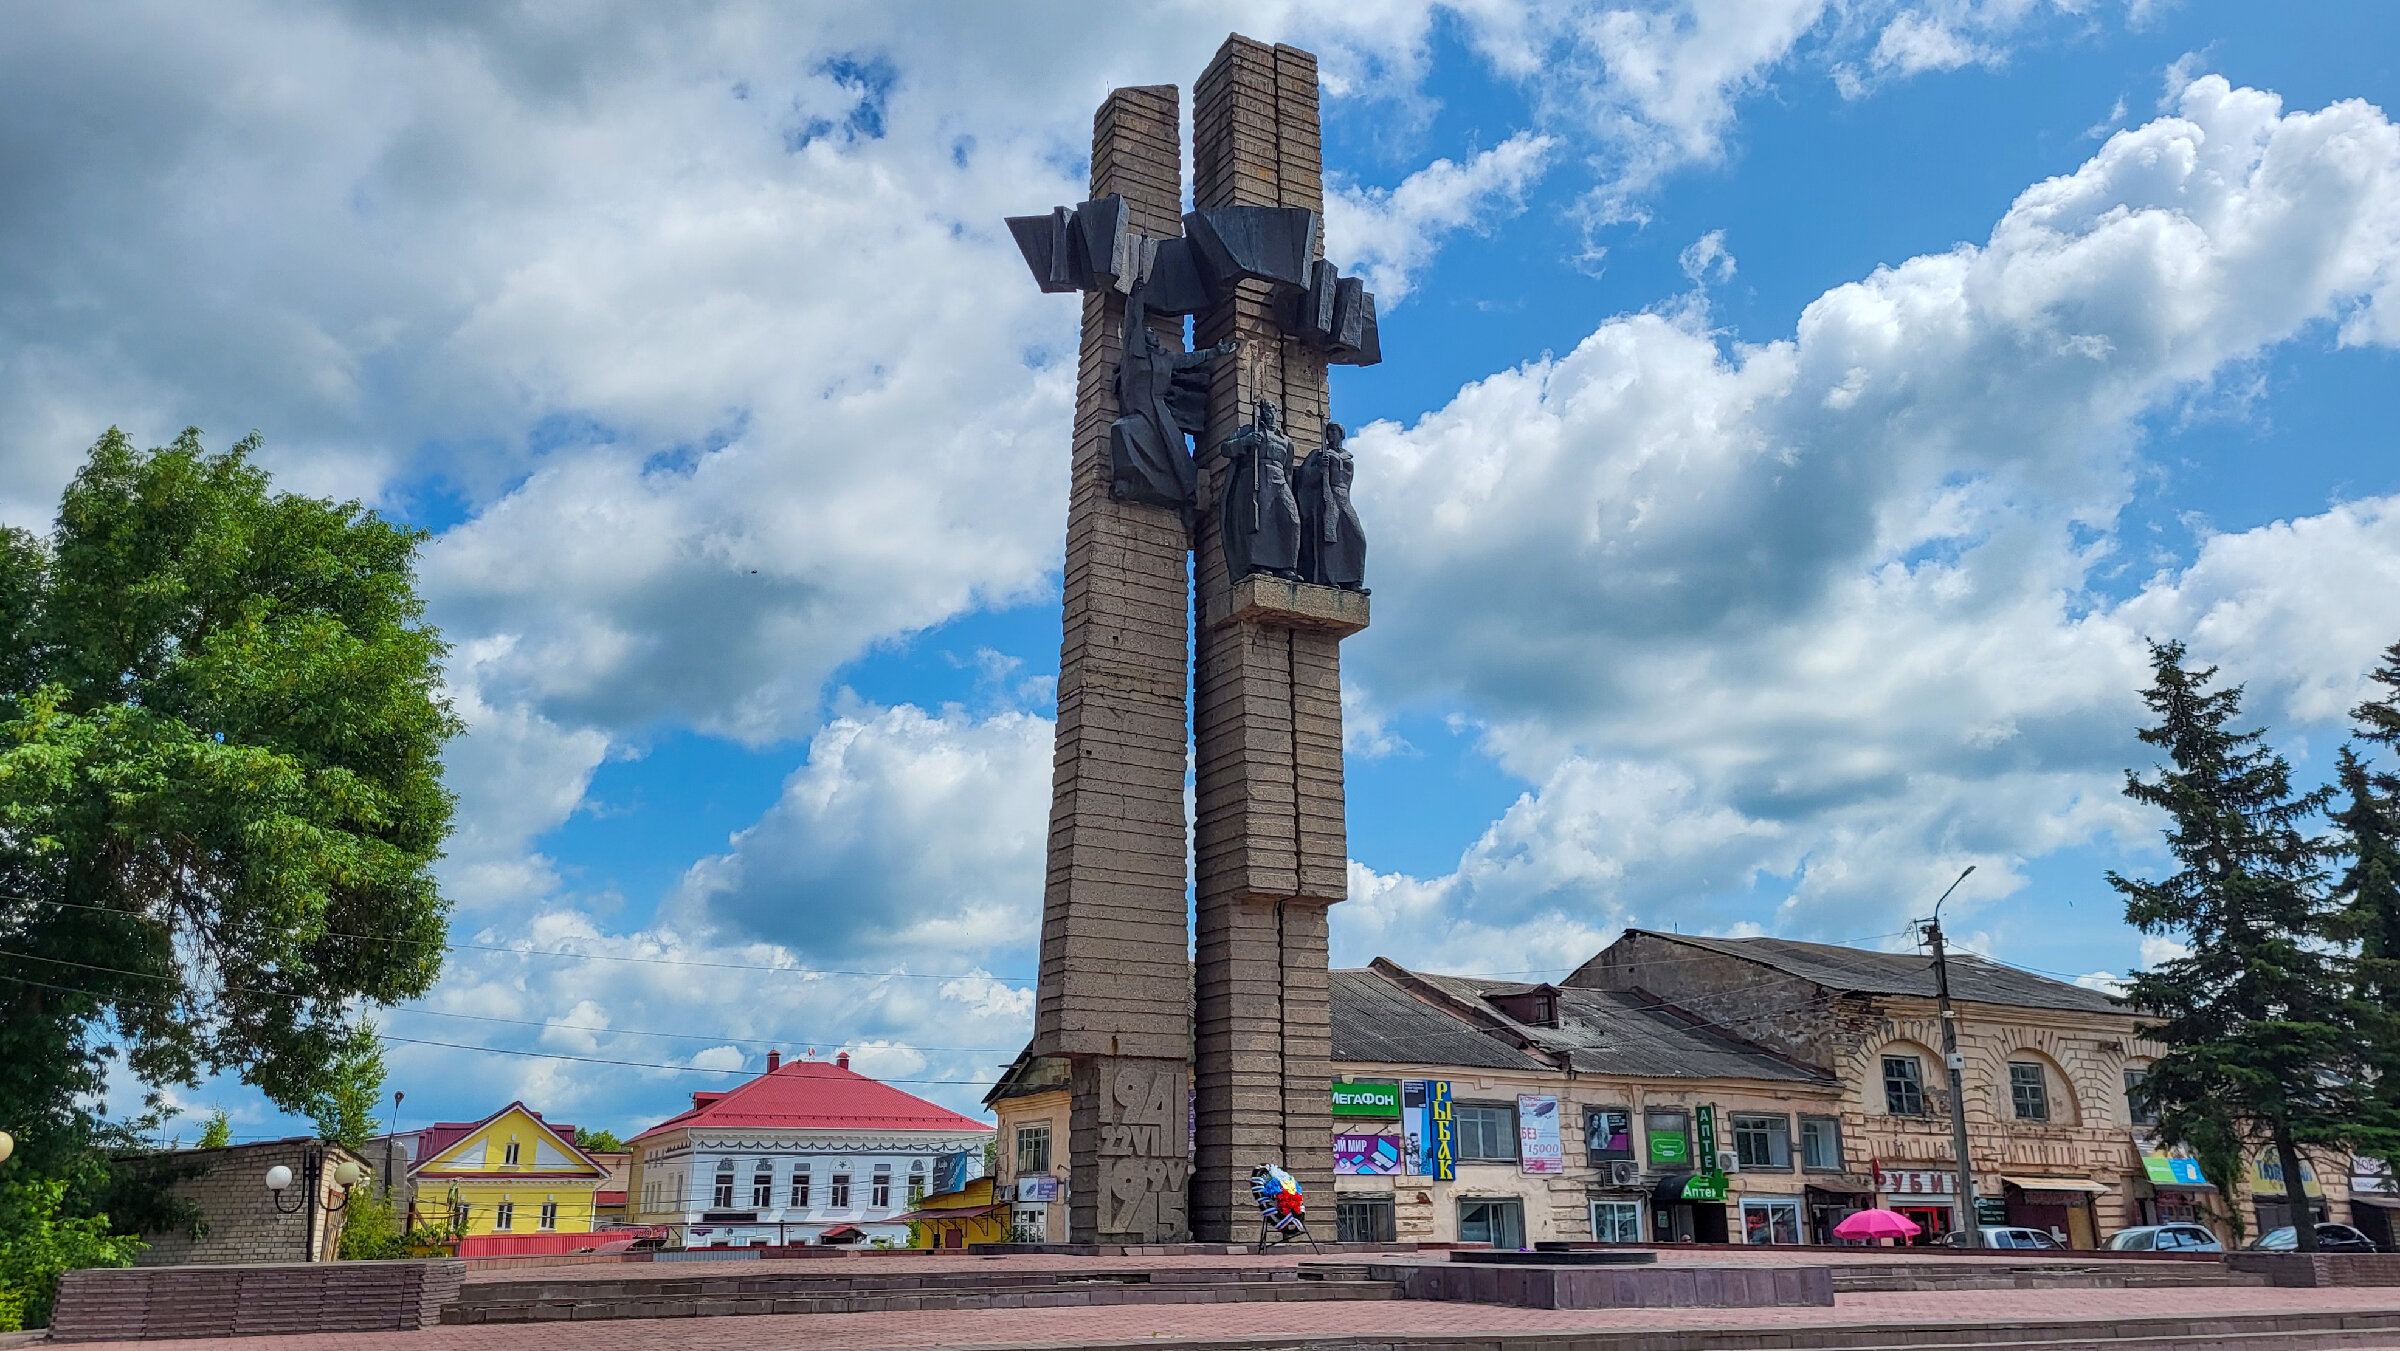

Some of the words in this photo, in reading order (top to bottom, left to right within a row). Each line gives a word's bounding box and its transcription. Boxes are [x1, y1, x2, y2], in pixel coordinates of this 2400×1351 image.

[1432, 1081, 1453, 1180] РЫБАК
[1347, 1139, 1367, 1153] МИР
[1528, 1143, 1559, 1155] 15000
